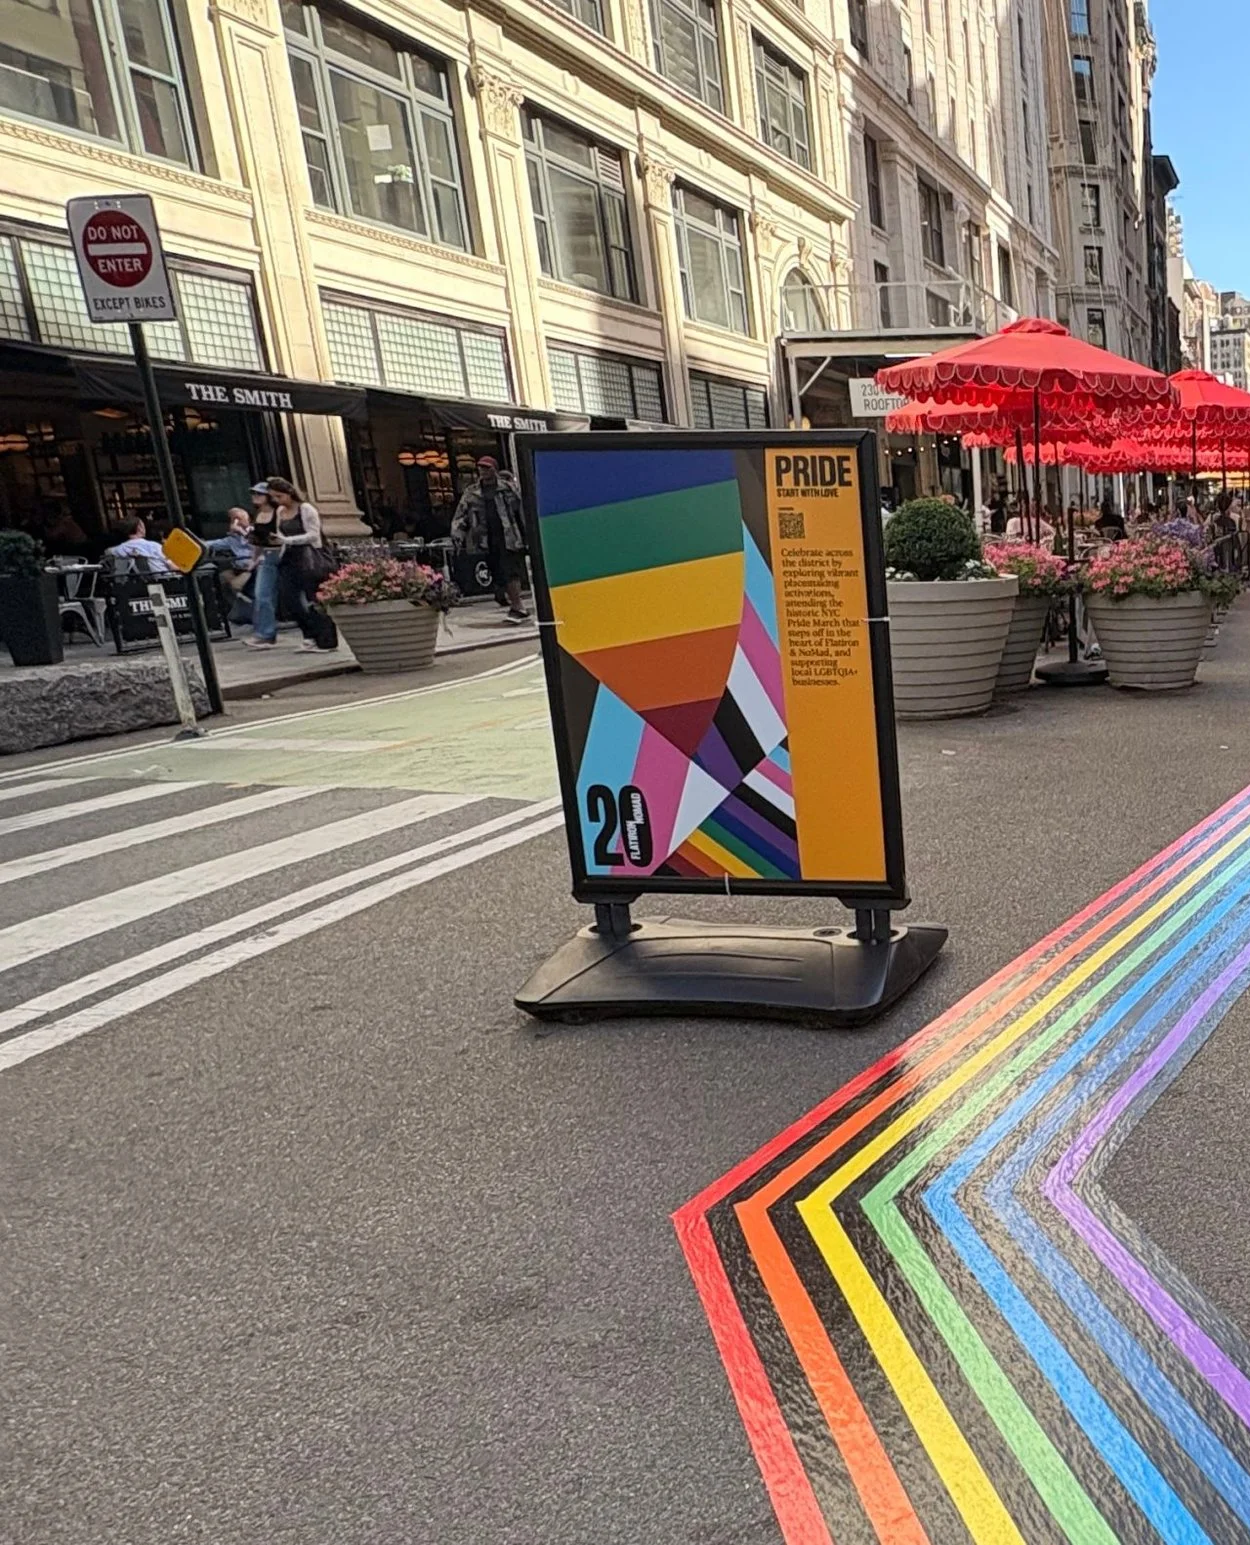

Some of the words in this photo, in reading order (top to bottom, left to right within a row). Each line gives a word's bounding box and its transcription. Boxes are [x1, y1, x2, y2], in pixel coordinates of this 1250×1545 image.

[88, 227, 107, 240] DO
[111, 225, 139, 239] NOT
[98, 258, 143, 273] ENTER
[93, 298, 131, 311] EXCEPT
[134, 296, 166, 309] BIKES
[184, 383, 229, 403] THE
[232, 387, 293, 409] SMITH
[487, 413, 512, 429] THE
[514, 417, 548, 432] SMITH
[775, 455, 852, 487] PRIDE
[777, 488, 799, 498] START
[801, 488, 820, 498] WITH
[820, 488, 839, 498] LOVE
[781, 548, 824, 557] Celebrate
[825, 549, 853, 557] across
[782, 558, 797, 567] the
[798, 558, 829, 567] district
[831, 558, 842, 568] by
[782, 568, 826, 580] exploring
[827, 569, 858, 577] vibrant
[784, 578, 839, 589] placemaking
[784, 589, 835, 598] activations,
[785, 598, 827, 608] attending
[829, 598, 843, 607] the
[786, 608, 820, 617] historic
[821, 608, 841, 617] NYC
[787, 619, 811, 627] Pride
[812, 618, 840, 627] March
[842, 618, 860, 627] that
[788, 629, 810, 639] steps
[812, 628, 824, 637] off
[826, 629, 835, 637] in
[836, 628, 851, 637] the
[789, 638, 812, 647] heart
[814, 638, 824, 647] of
[825, 638, 860, 647] Flatiron
[789, 648, 796, 657] &
[799, 648, 833, 657] NoMad,
[835, 648, 851, 657] and
[791, 658, 838, 669] supporting
[791, 668, 812, 676] local
[814, 668, 858, 677] LGBTQIA+
[792, 678, 840, 686] businesses.
[630, 792, 645, 824] NOMAD
[625, 820, 641, 860] FLATIRON
